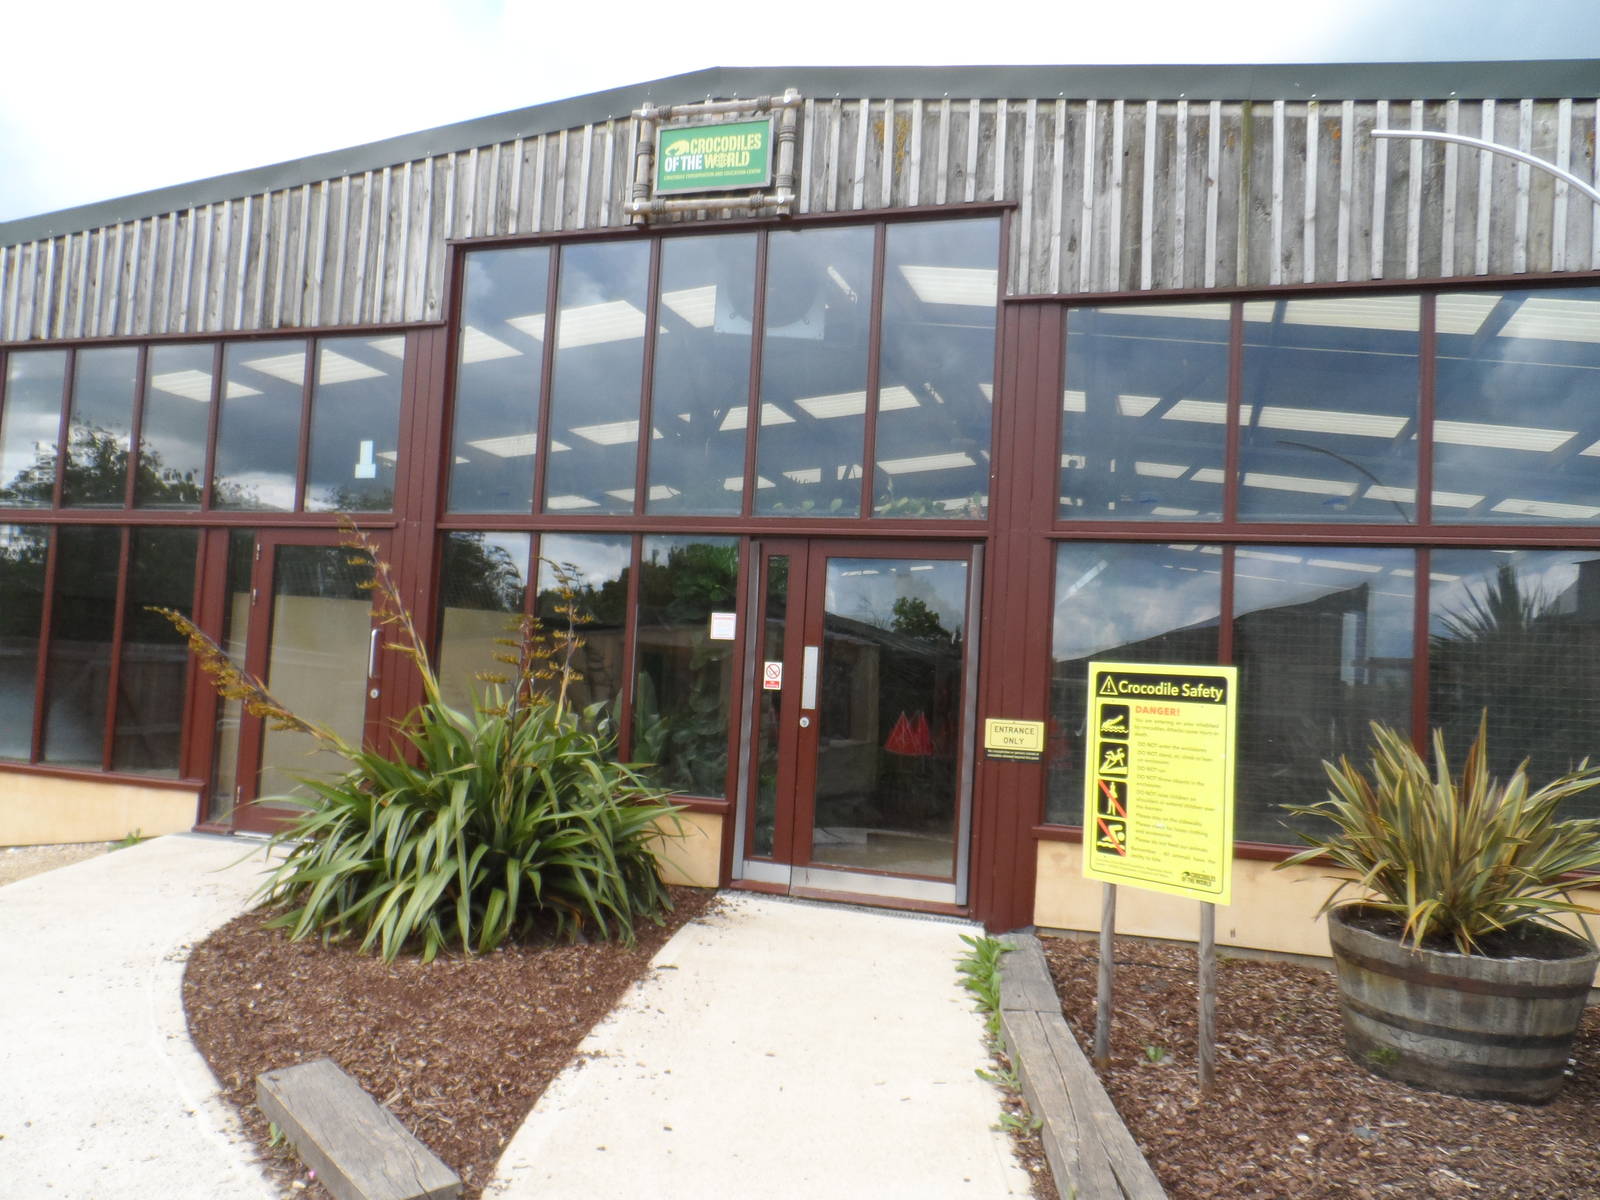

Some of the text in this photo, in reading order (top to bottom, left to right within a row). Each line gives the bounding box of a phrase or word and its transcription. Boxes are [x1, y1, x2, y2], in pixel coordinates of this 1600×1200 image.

[690, 133, 762, 154] CROCODILES
[664, 151, 750, 173] OF THE WORLD
[1118, 680, 1223, 702] Crocodile Safety
[1135, 705, 1181, 717] DANGER!
[994, 725, 1035, 735] ENTRANCE
[1003, 737, 1025, 745] ONLY
